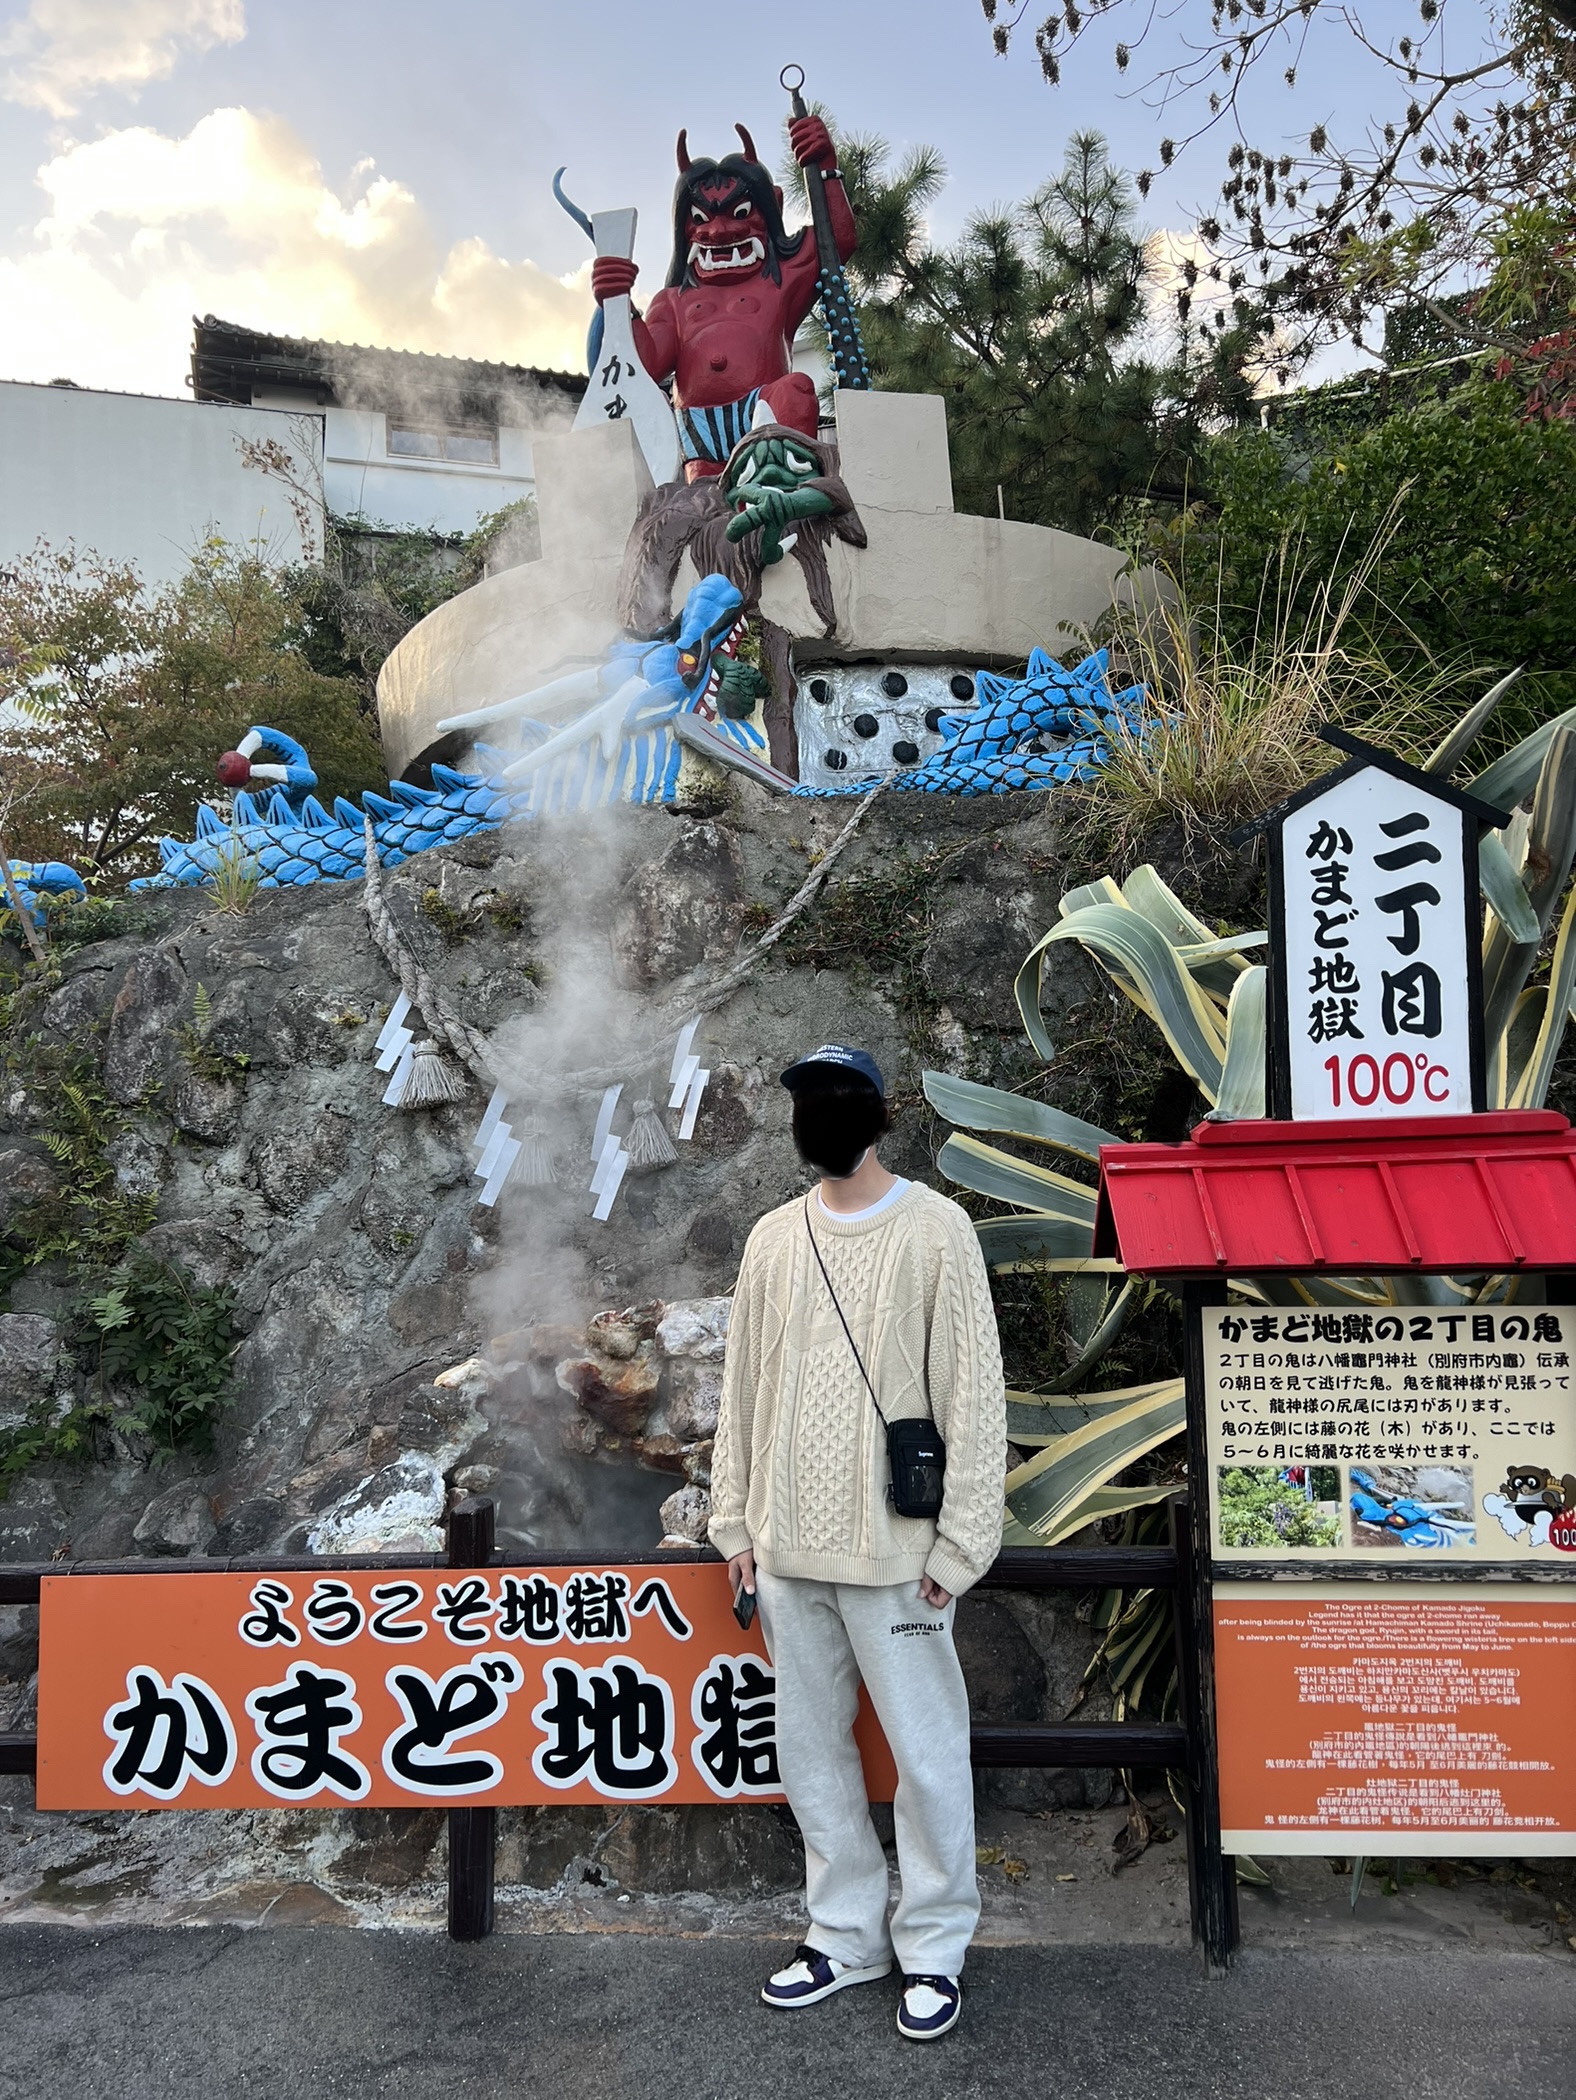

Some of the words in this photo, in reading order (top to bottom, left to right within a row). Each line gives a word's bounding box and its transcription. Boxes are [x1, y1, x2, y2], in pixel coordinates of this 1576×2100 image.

[1374, 813, 1441, 1038] 二丁目
[1306, 821, 1364, 1043] かまど地獄
[1219, 1313, 1562, 1343] かまど地獄の2丁目の鬼
[1221, 1398, 1510, 1413] いて、龍神様の尻尾には刃があります。
[244, 1577, 687, 1641] ようこそ地獄へ
[1308, 1611, 1339, 1619] Legend
[1339, 1611, 1356, 1619] has
[891, 1622, 944, 1634] ESSENTIALS
[1306, 1618, 1321, 1626] the
[1321, 1618, 1353, 1626] sunrise
[1542, 1621, 1571, 1629] Beppu
[1311, 1626, 1328, 1634] The
[1328, 1626, 1359, 1634] dragon
[1408, 1627, 1427, 1635] with
[1434, 1627, 1461, 1635] sword
[1301, 1634, 1333, 1642] outlook
[1333, 1634, 1347, 1642] for
[1346, 1634, 1361, 1642] the
[1544, 1636, 1559, 1644] left
[1365, 1642, 1397, 1650] blooms
[1396, 1642, 1441, 1651] beautifully
[1461, 1643, 1480, 1651] May
